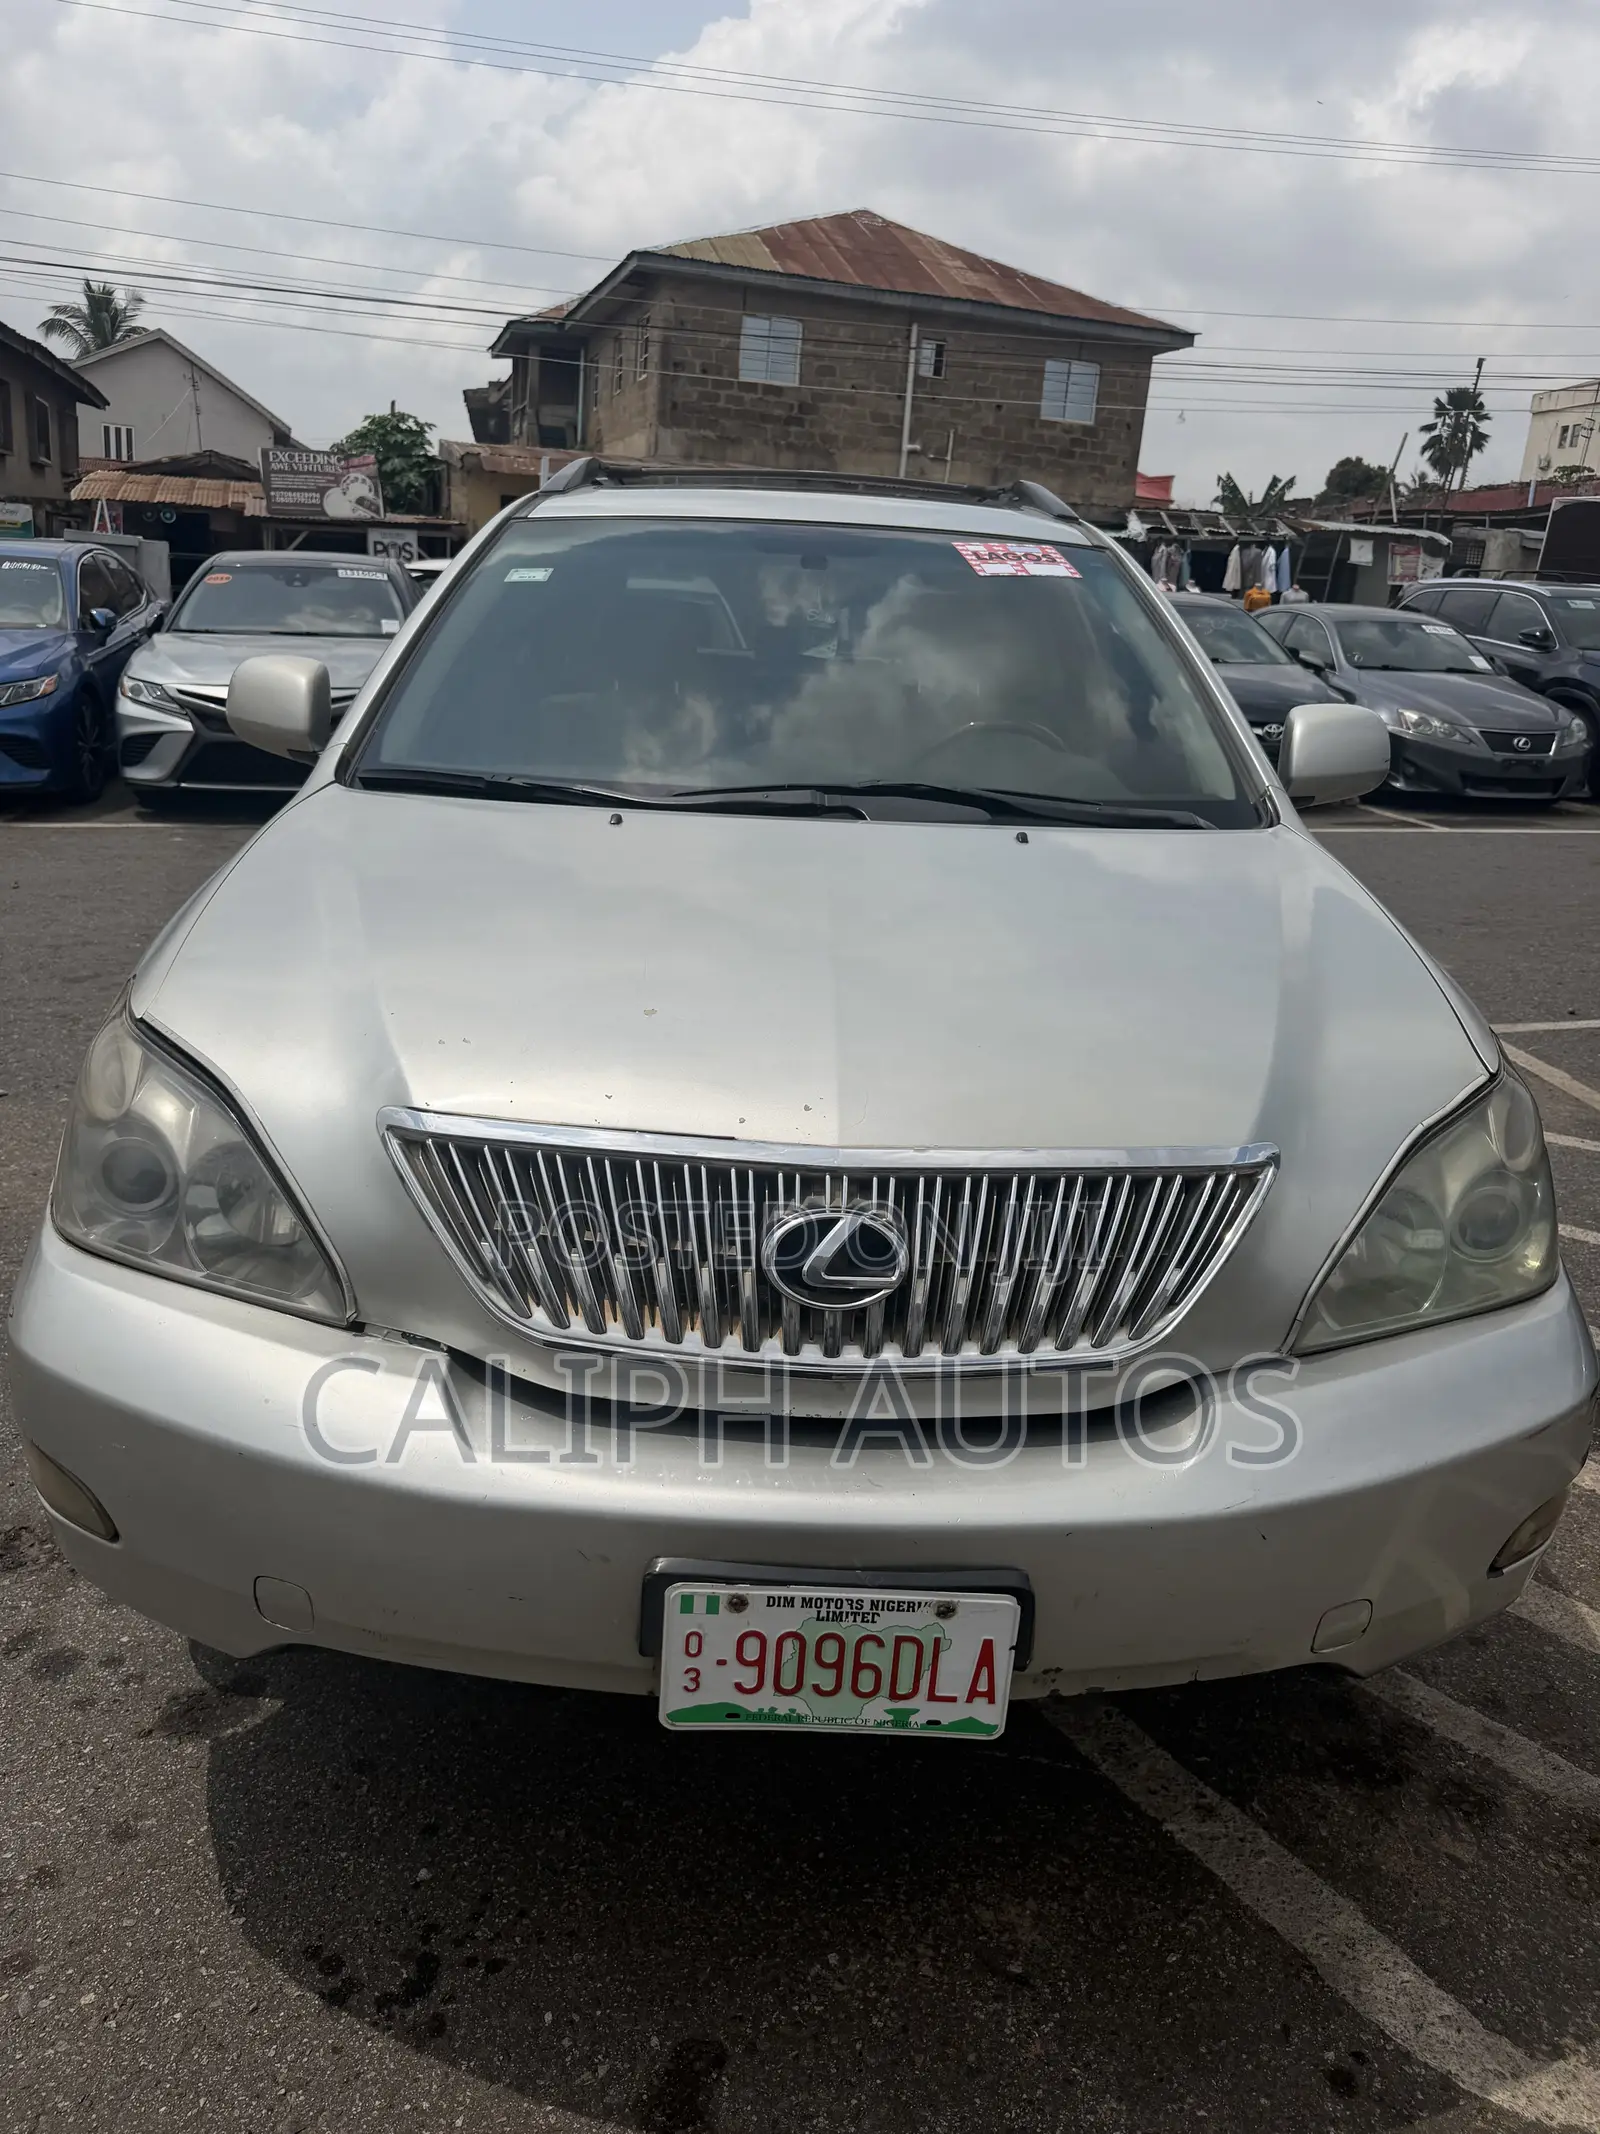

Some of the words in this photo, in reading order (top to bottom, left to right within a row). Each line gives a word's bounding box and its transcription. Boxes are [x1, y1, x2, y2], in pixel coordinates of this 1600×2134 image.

[268, 450, 346, 466] EXCEEDING
[973, 551, 1057, 563] LAGOS
[766, 1595, 795, 1608] DIM
[801, 1597, 864, 1611] MOTORS
[869, 1599, 932, 1613] NIGERI
[745, 1712, 796, 1723] FEDERAL
[797, 1714, 855, 1726] REPUBLIC
[855, 1717, 871, 1726] OF
[873, 1718, 920, 1729] NIGERIA
